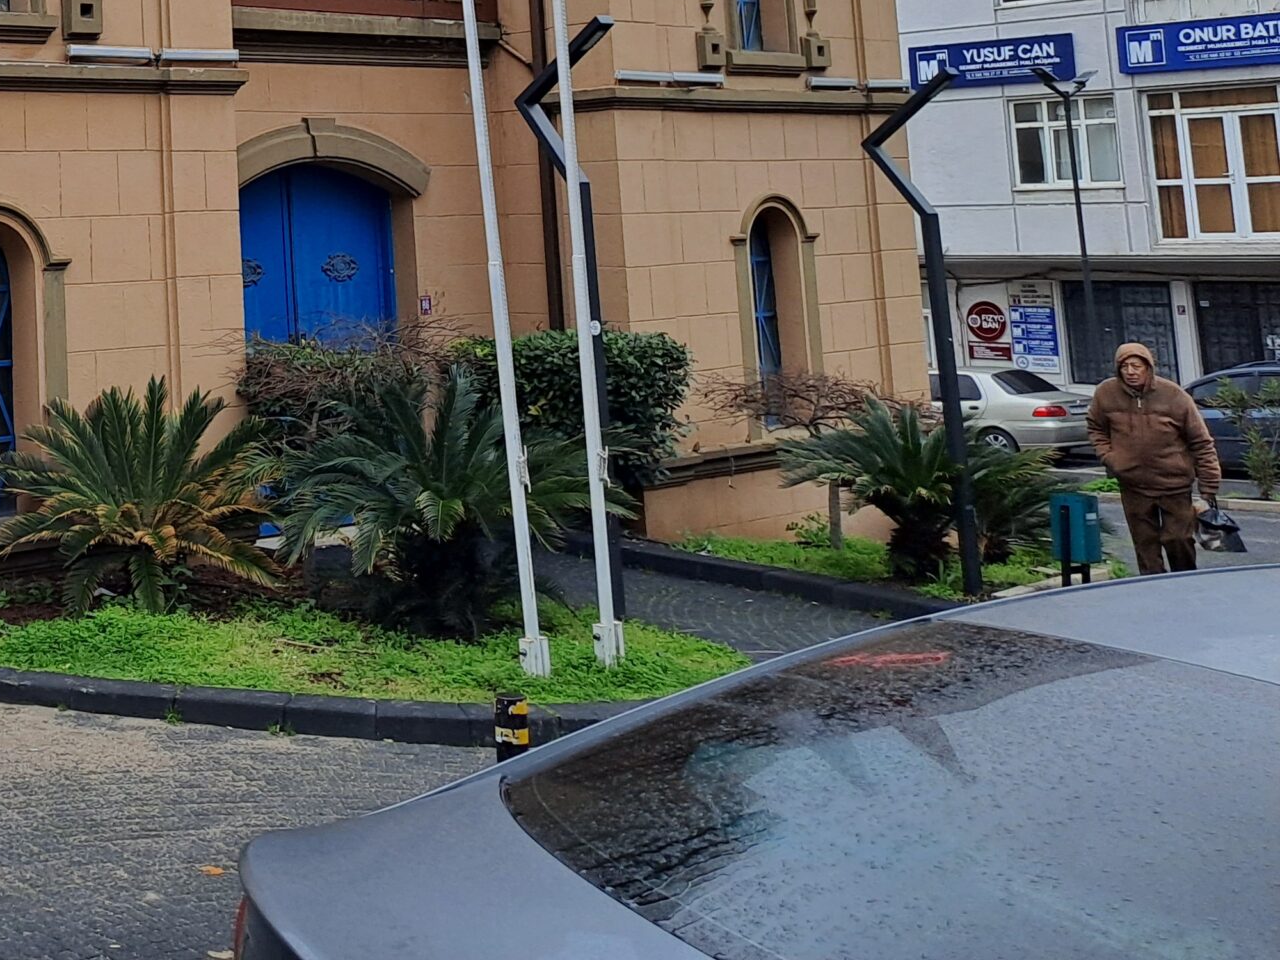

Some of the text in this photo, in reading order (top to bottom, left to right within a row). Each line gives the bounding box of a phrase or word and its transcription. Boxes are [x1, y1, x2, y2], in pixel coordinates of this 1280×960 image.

[1178, 24, 1236, 44] ONUR
[963, 42, 1055, 63] YUSUF CAN
[982, 321, 999, 329] BAN
